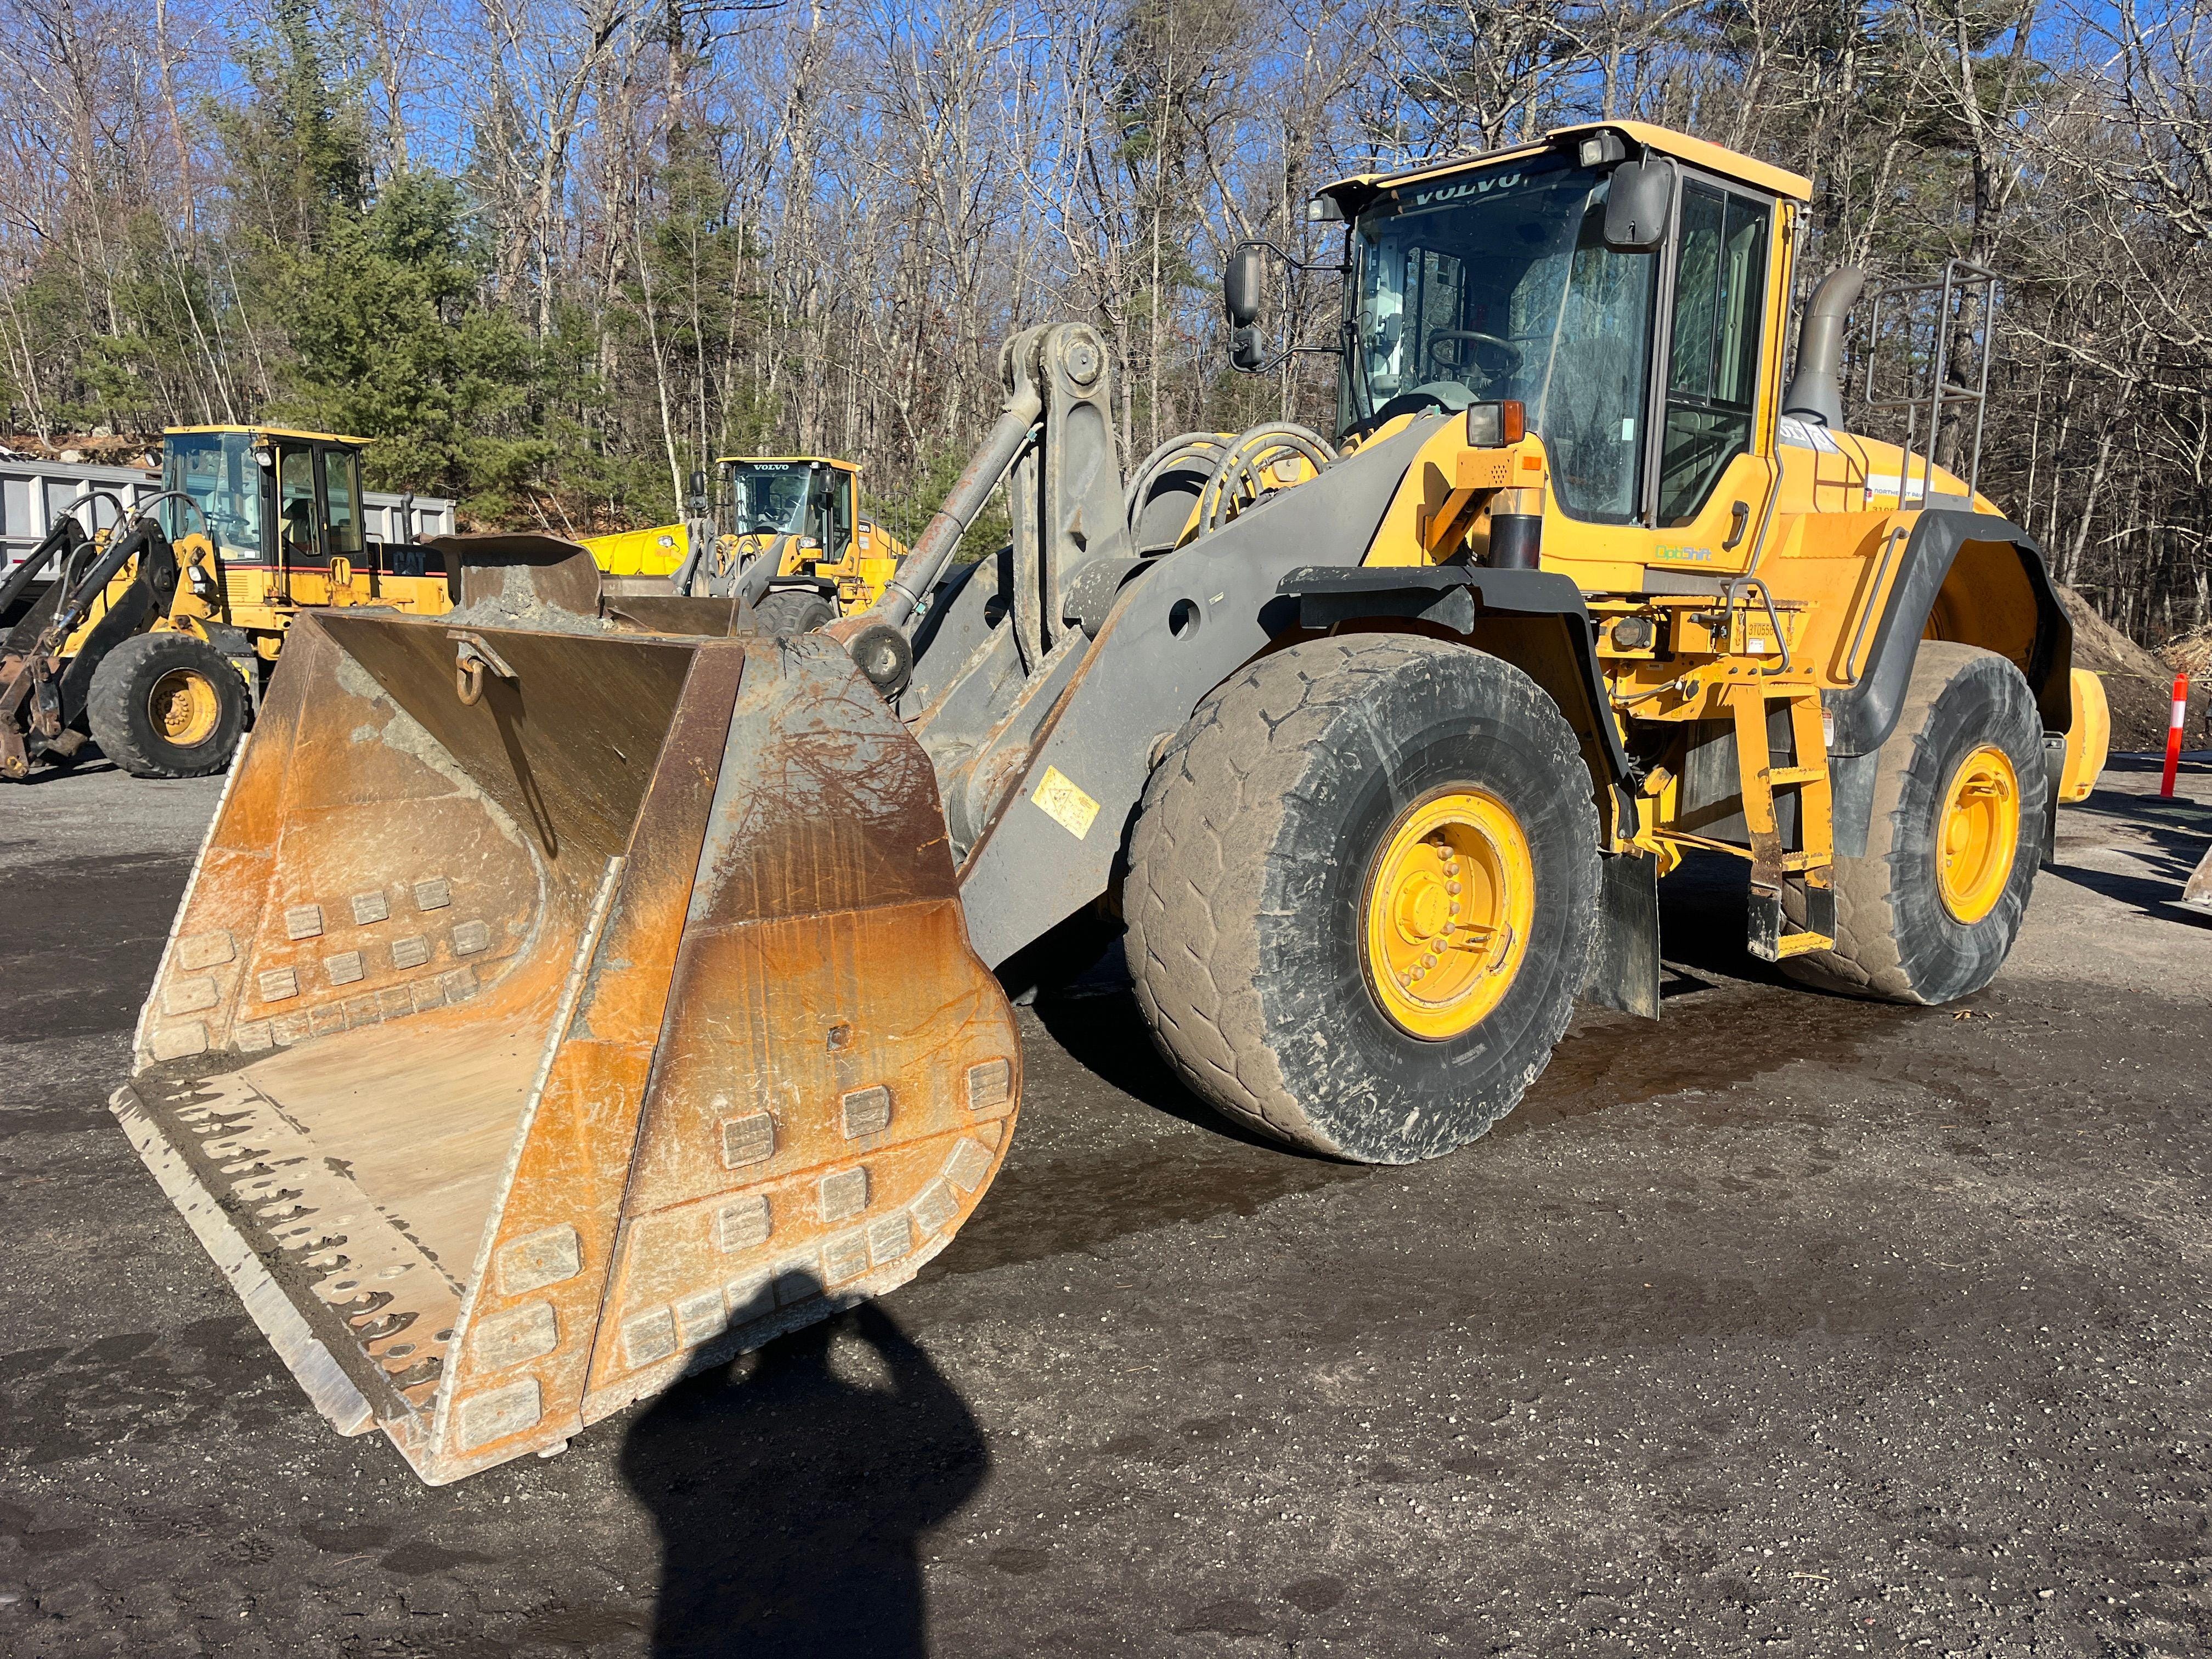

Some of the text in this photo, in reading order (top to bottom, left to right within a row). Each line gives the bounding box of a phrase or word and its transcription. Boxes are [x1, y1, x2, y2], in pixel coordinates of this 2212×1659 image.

[1417, 173, 1521, 205] VOLVO
[1780, 422, 1830, 446] OLVO
[393, 551, 426, 574] CAT
[1656, 545, 1712, 561] OptiShift
